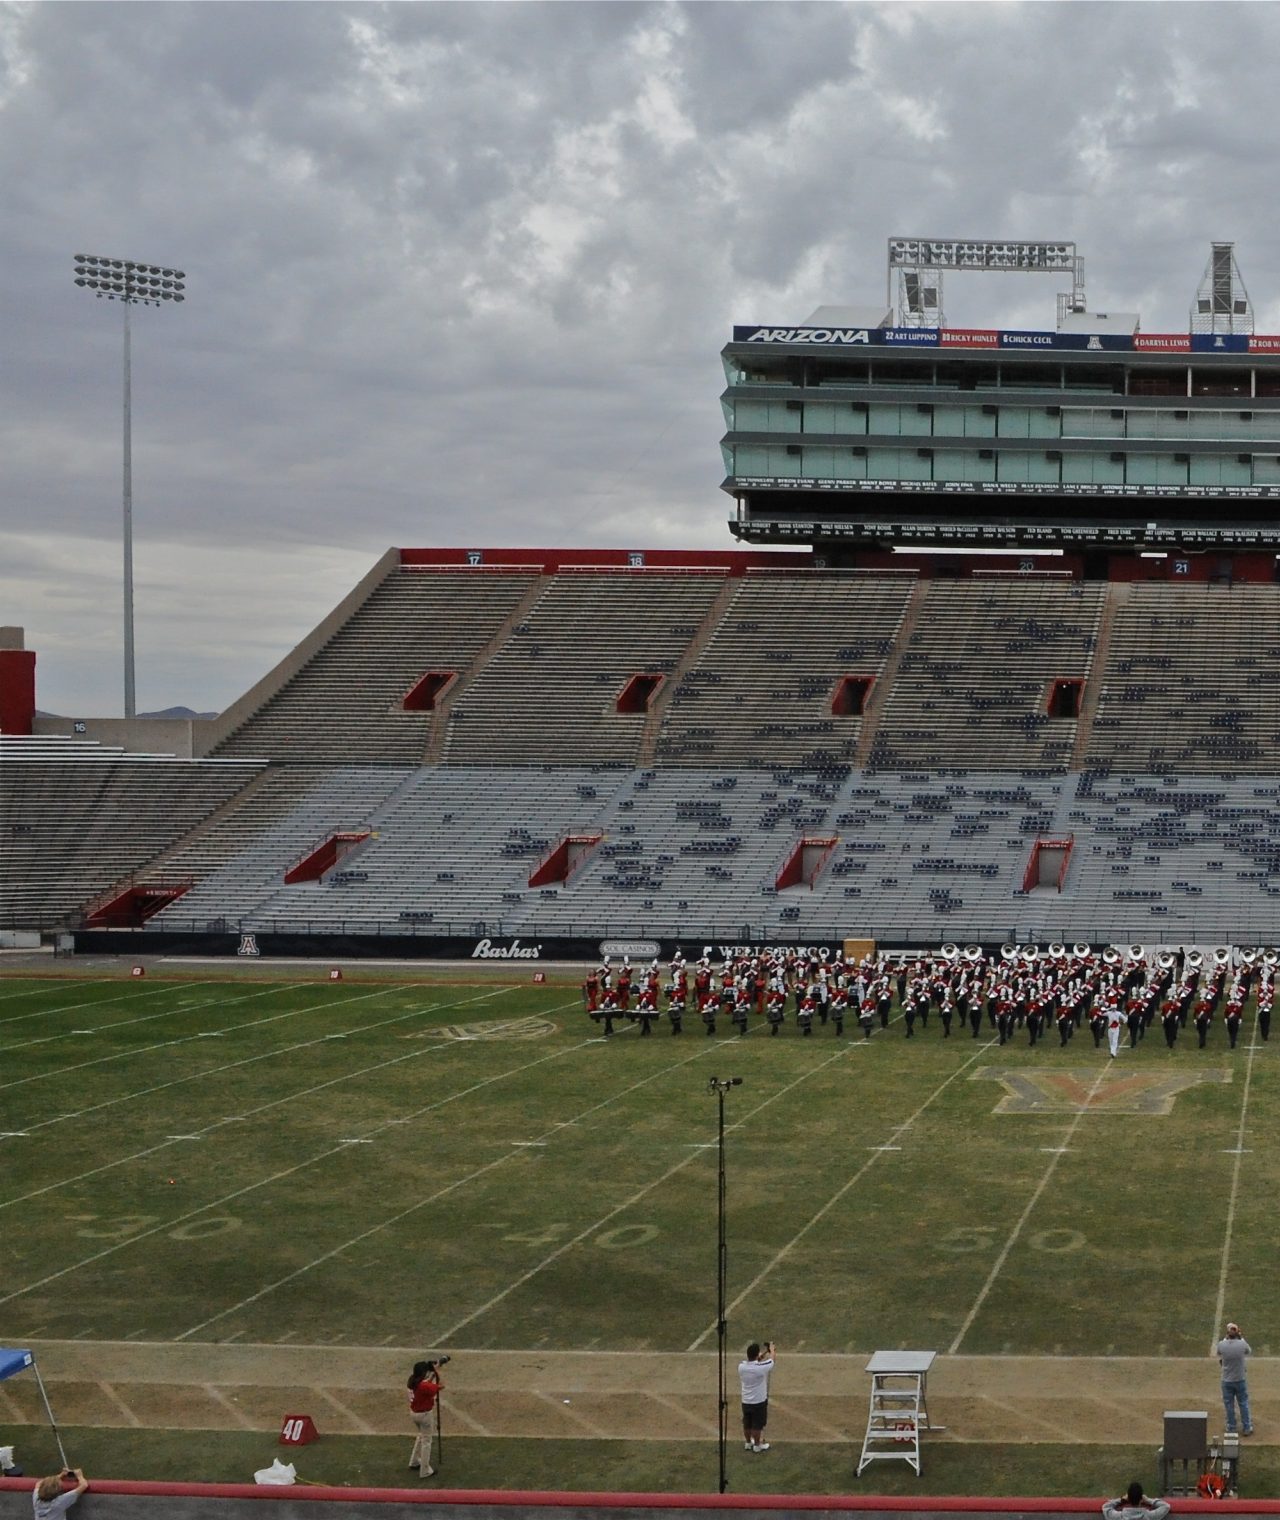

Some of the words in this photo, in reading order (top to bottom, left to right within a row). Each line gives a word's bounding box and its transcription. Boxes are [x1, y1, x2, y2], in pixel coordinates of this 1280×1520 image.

[747, 329, 870, 343] ARIZONA
[885, 332, 894, 340] 22
[894, 333, 908, 341] ART
[908, 333, 938, 342] LUPPINO
[951, 334, 971, 342] RICKY
[971, 334, 998, 343] HUNLEY
[1009, 336, 1032, 344] CHUCK
[1034, 337, 1053, 345] CECIL
[1134, 338, 1139, 346] 4
[1140, 339, 1168, 347] DARRYLL
[470, 556, 480, 565] 17
[631, 558, 642, 567] 18
[815, 560, 826, 568] 19
[1020, 562, 1034, 571] 20
[1176, 564, 1188, 573] 21
[74, 723, 86, 732] 16
[238, 935, 260, 956] A
[472, 939, 543, 958] Bashas'
[283, 1419, 304, 1441] 40
[896, 1424, 912, 1441] 50
